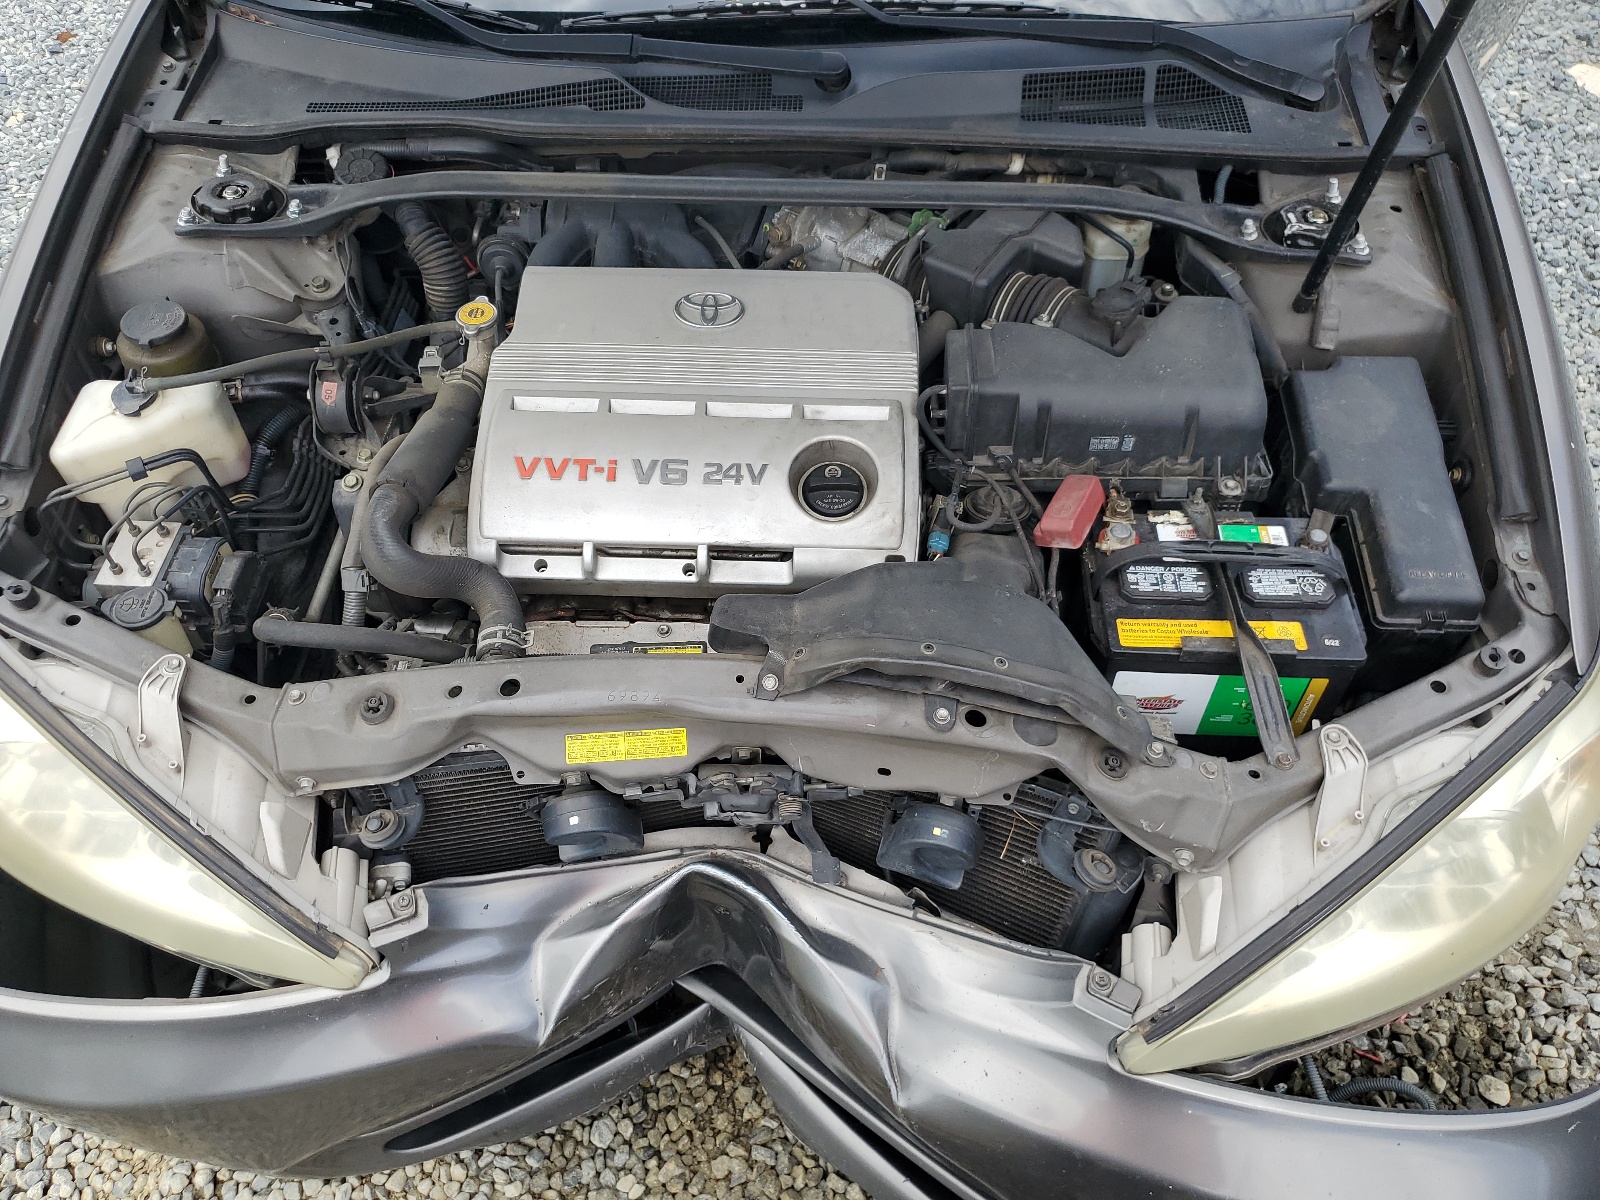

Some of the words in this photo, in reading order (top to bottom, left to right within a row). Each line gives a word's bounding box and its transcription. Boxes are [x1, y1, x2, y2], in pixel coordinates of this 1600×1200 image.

[513, 455, 618, 483] VVT-i
[631, 458, 689, 486] V6
[702, 462, 770, 486] 24V
[607, 690, 662, 703] 69894
